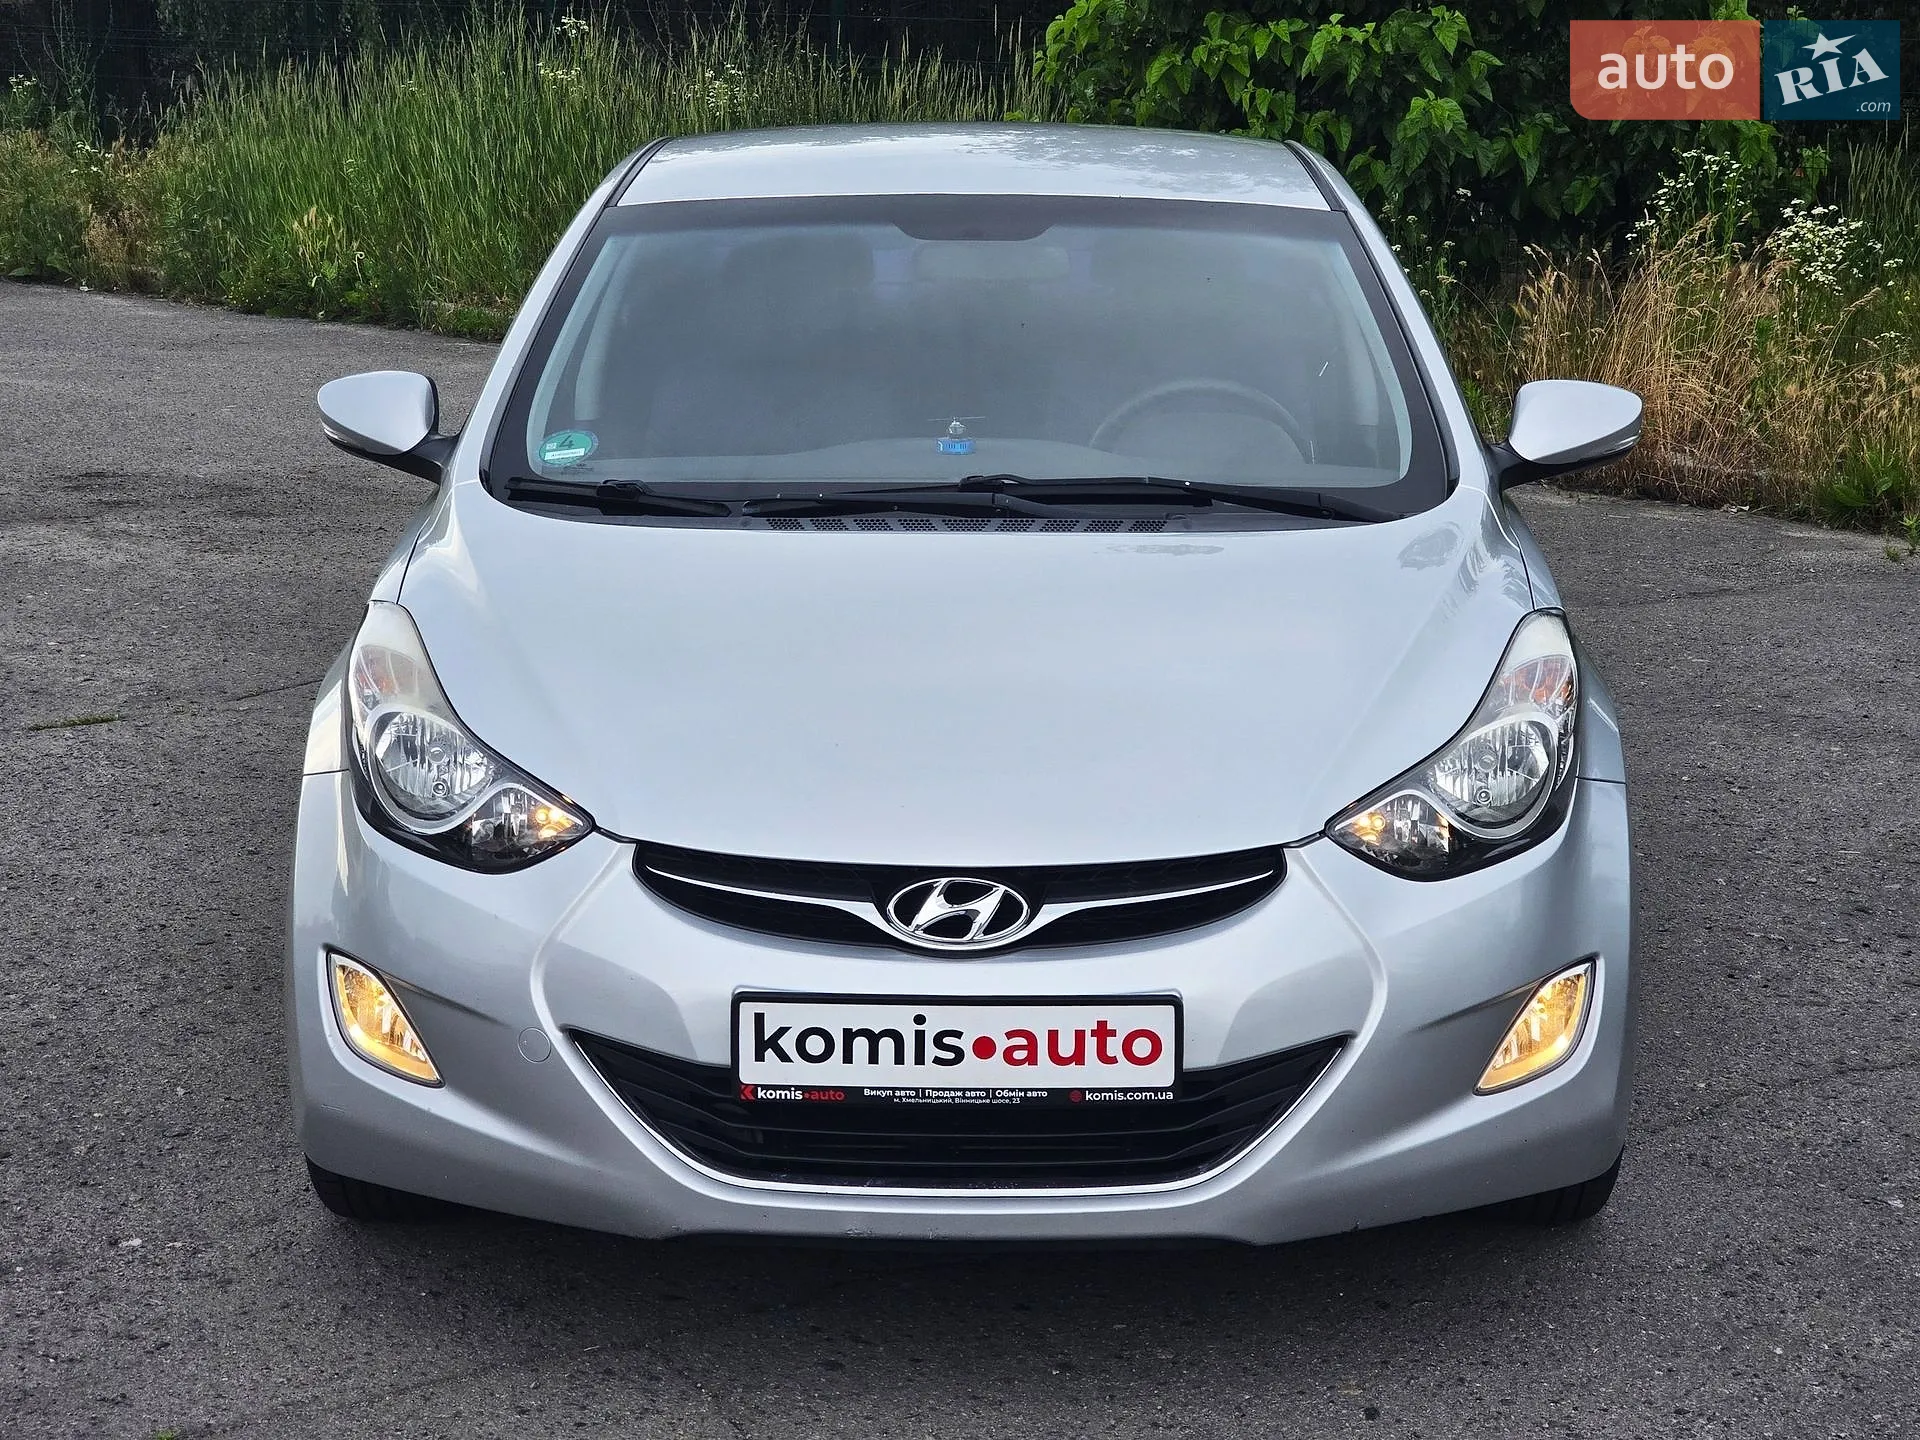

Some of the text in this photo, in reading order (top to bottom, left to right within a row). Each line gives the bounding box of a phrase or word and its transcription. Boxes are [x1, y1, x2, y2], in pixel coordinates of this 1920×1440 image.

[559, 434, 575, 449] 4
[863, 1088, 893, 1098] Викуп
[894, 1089, 916, 1097] авто
[925, 1089, 963, 1098] Продаж
[995, 1089, 1024, 1097] Обмін
[1085, 1089, 1174, 1101] komis.com.ua
